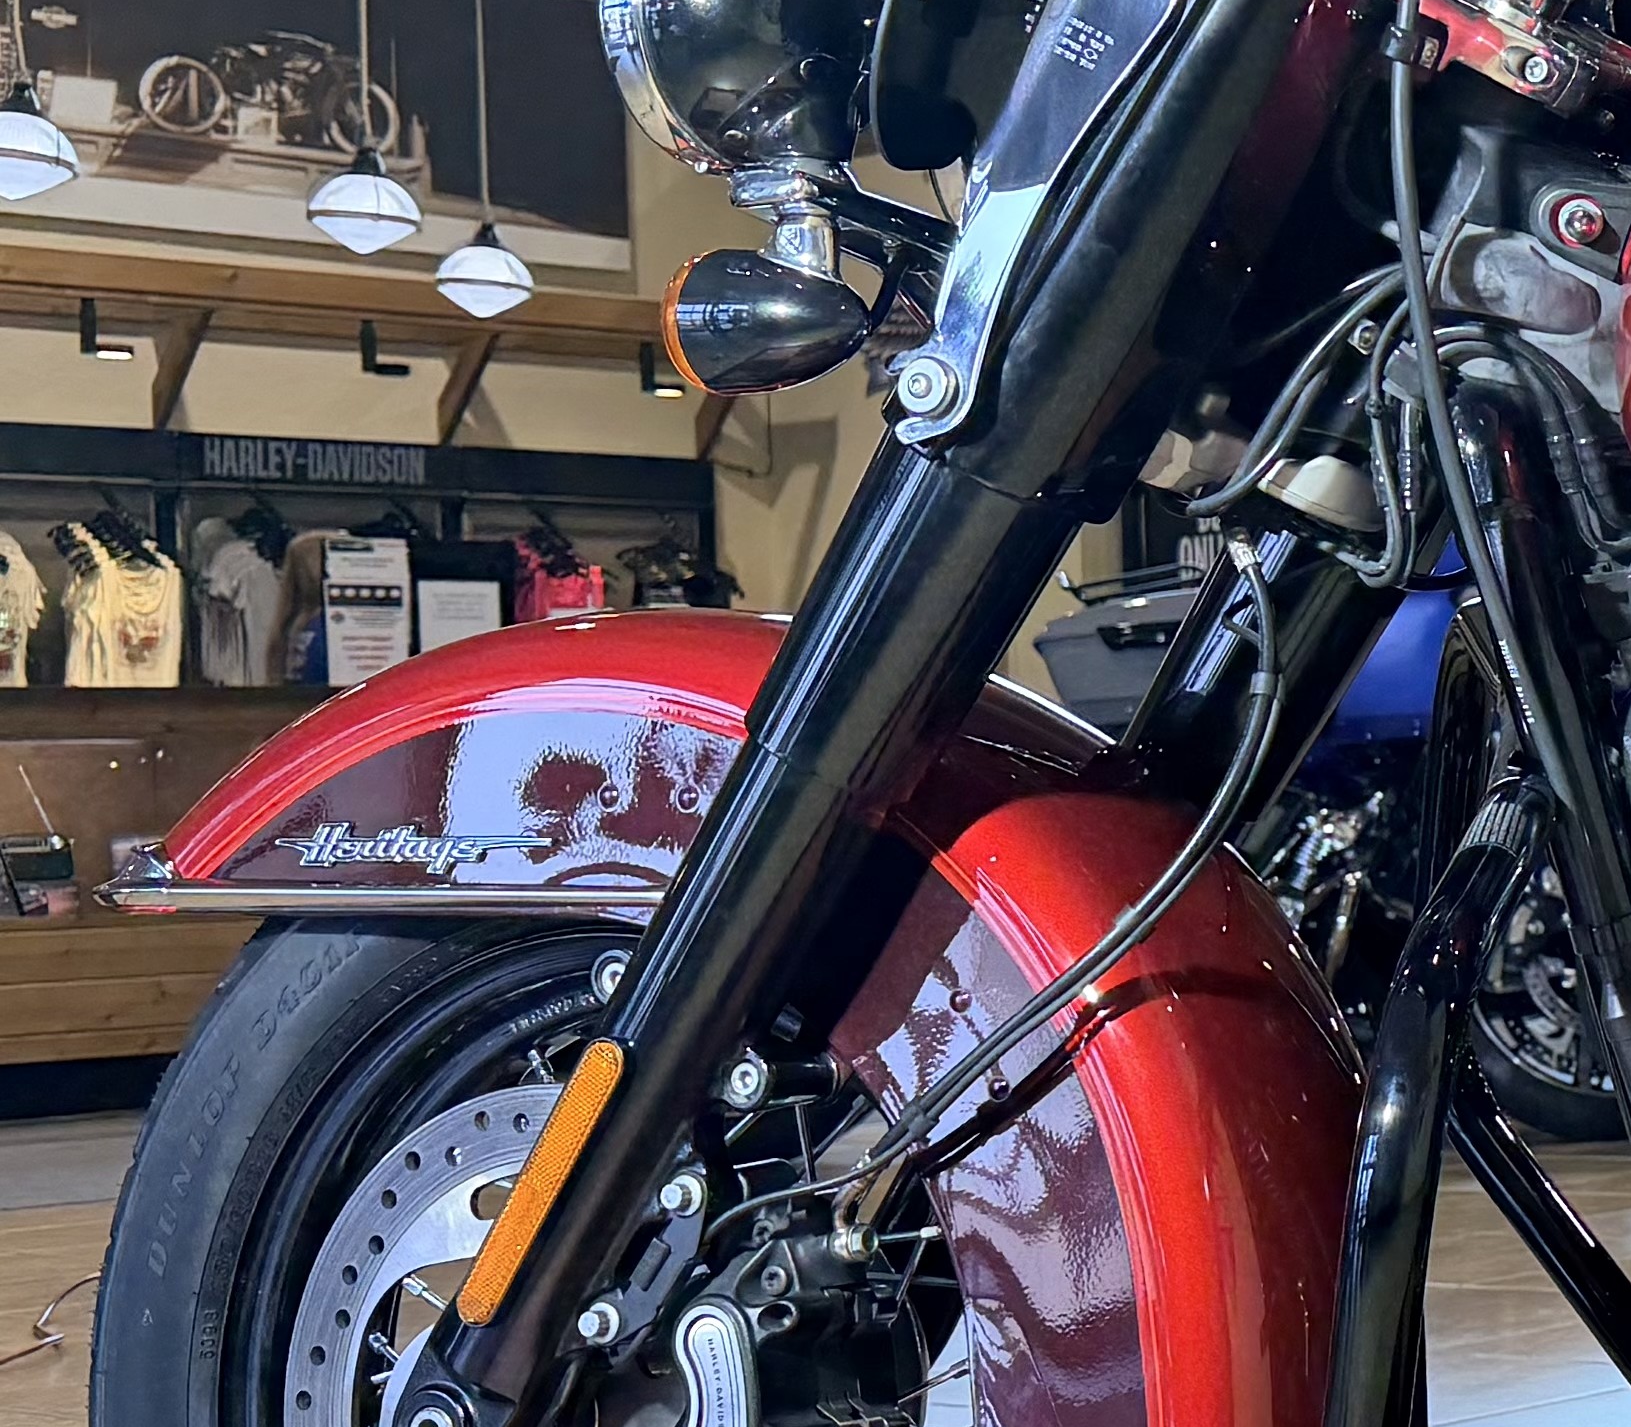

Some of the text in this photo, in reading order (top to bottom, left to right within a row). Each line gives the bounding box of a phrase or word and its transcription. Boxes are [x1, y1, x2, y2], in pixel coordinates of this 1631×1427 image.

[203, 436, 427, 486] HARLEY-DAVIDSON
[295, 822, 500, 874] Heritage
[147, 1052, 244, 1280] DUNLOP
